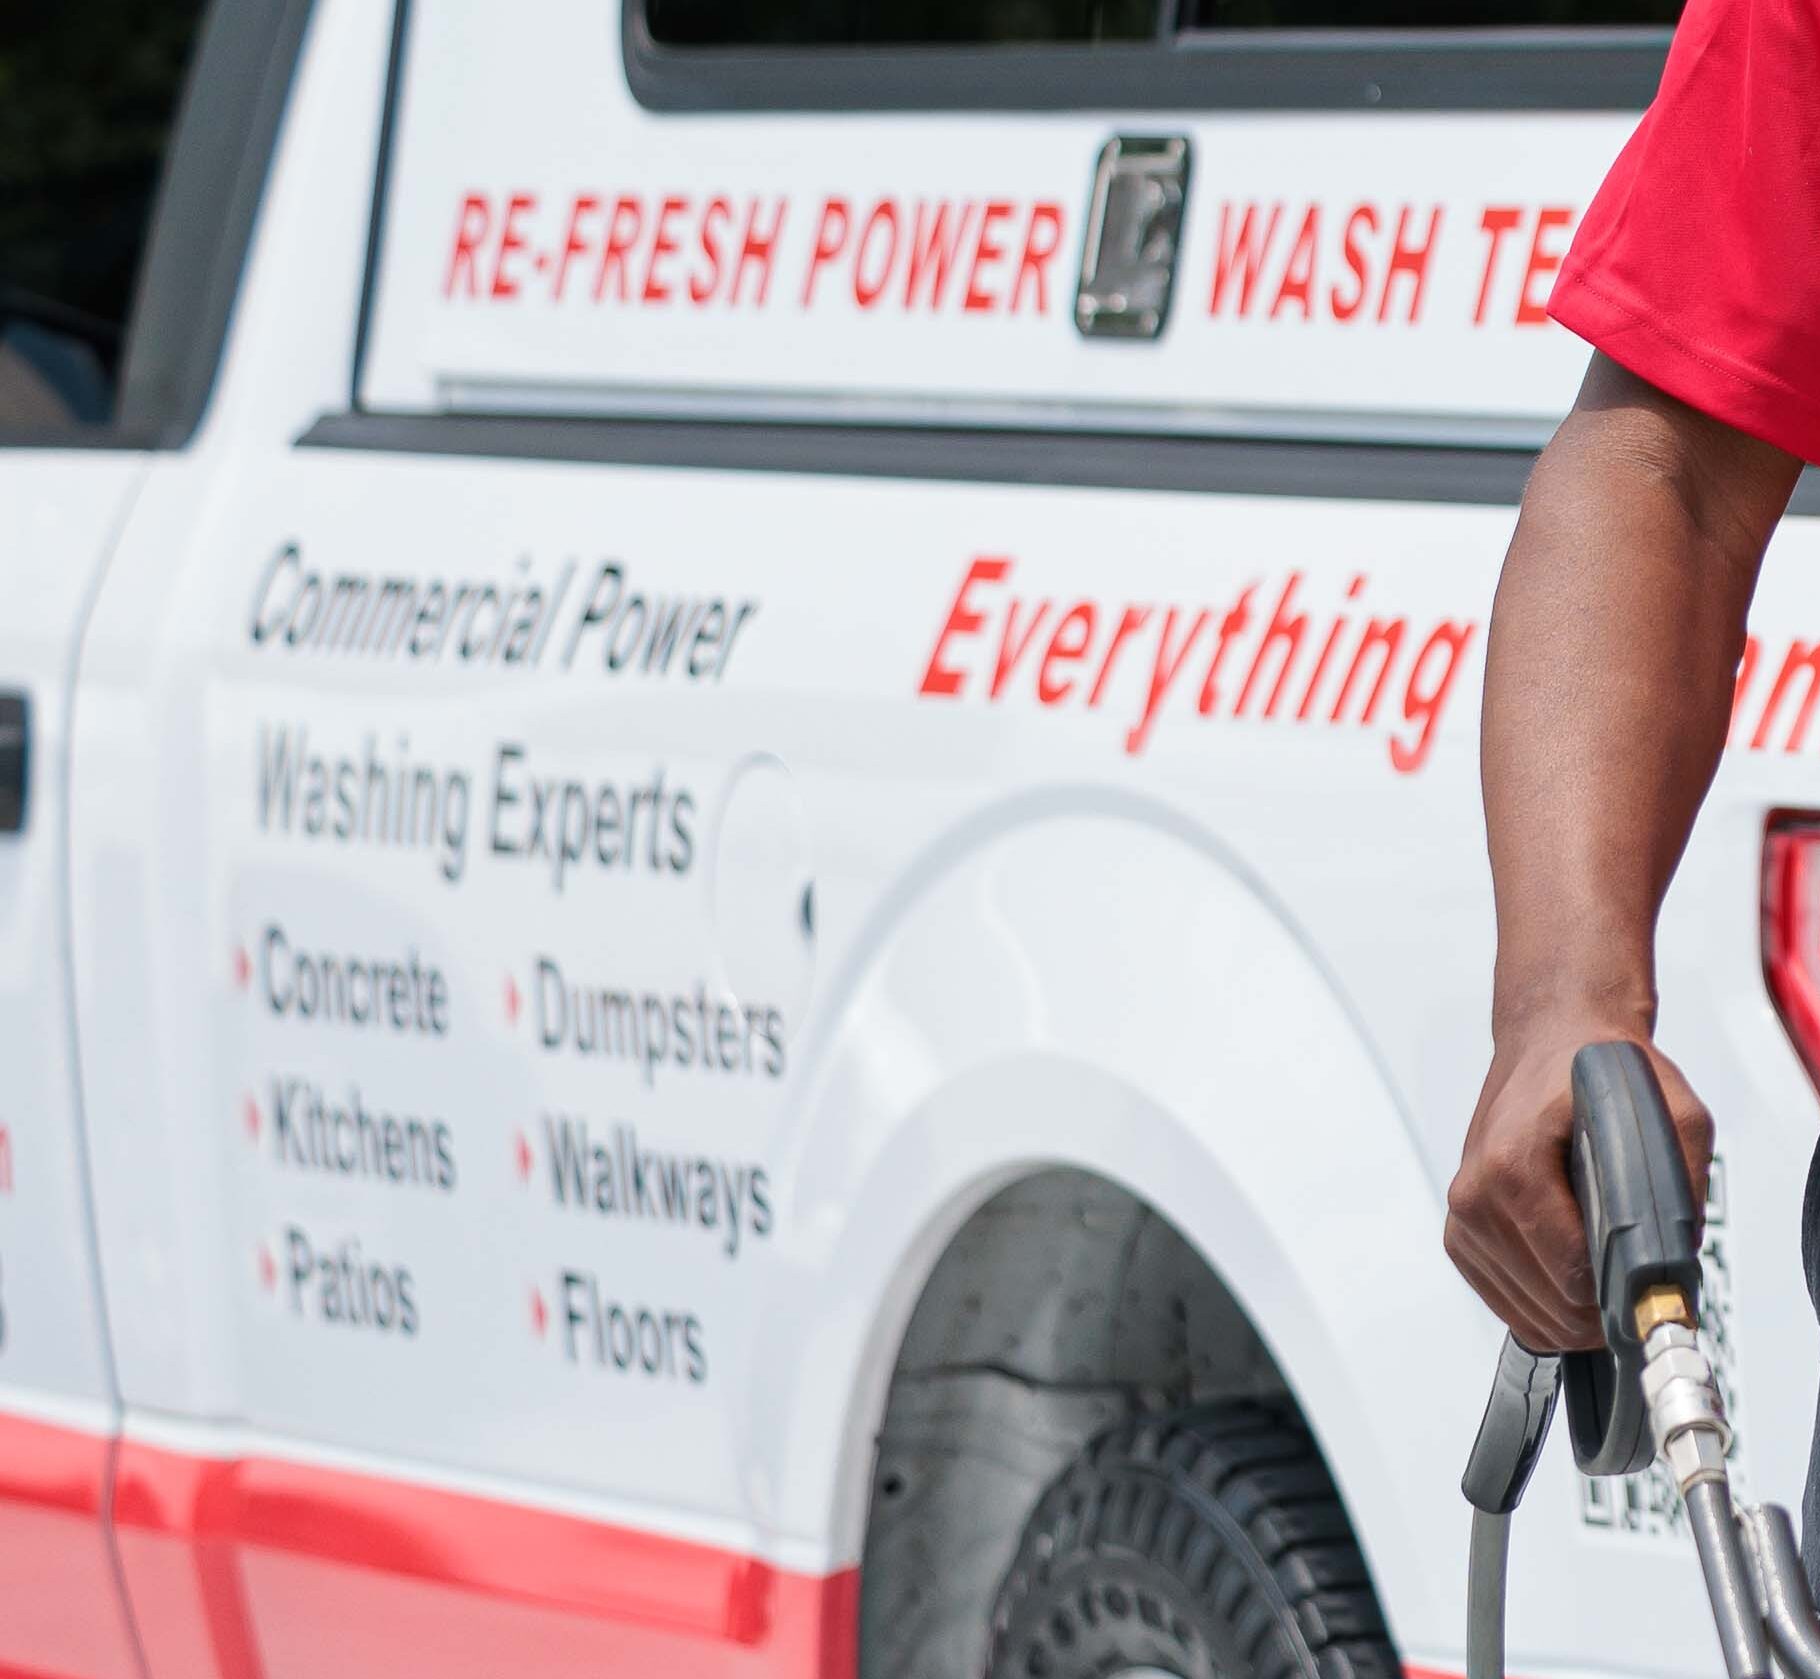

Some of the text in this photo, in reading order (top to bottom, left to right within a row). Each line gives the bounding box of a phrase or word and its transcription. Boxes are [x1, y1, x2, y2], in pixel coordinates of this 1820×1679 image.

[444, 194, 786, 308] RE-FRESH
[800, 199, 1064, 312] POWER
[1208, 202, 1442, 326] WASH
[250, 540, 758, 682] Commercial Power
[918, 555, 1475, 775] Everything
[256, 722, 697, 888] Washing Experts
[262, 924, 452, 1040] Concrete
[534, 956, 787, 1088] Dumpsters
[270, 1076, 456, 1194] Kitchens
[542, 1114, 776, 1256] Walkways
[286, 1224, 421, 1340] Patios
[556, 1268, 708, 1386] Floors
